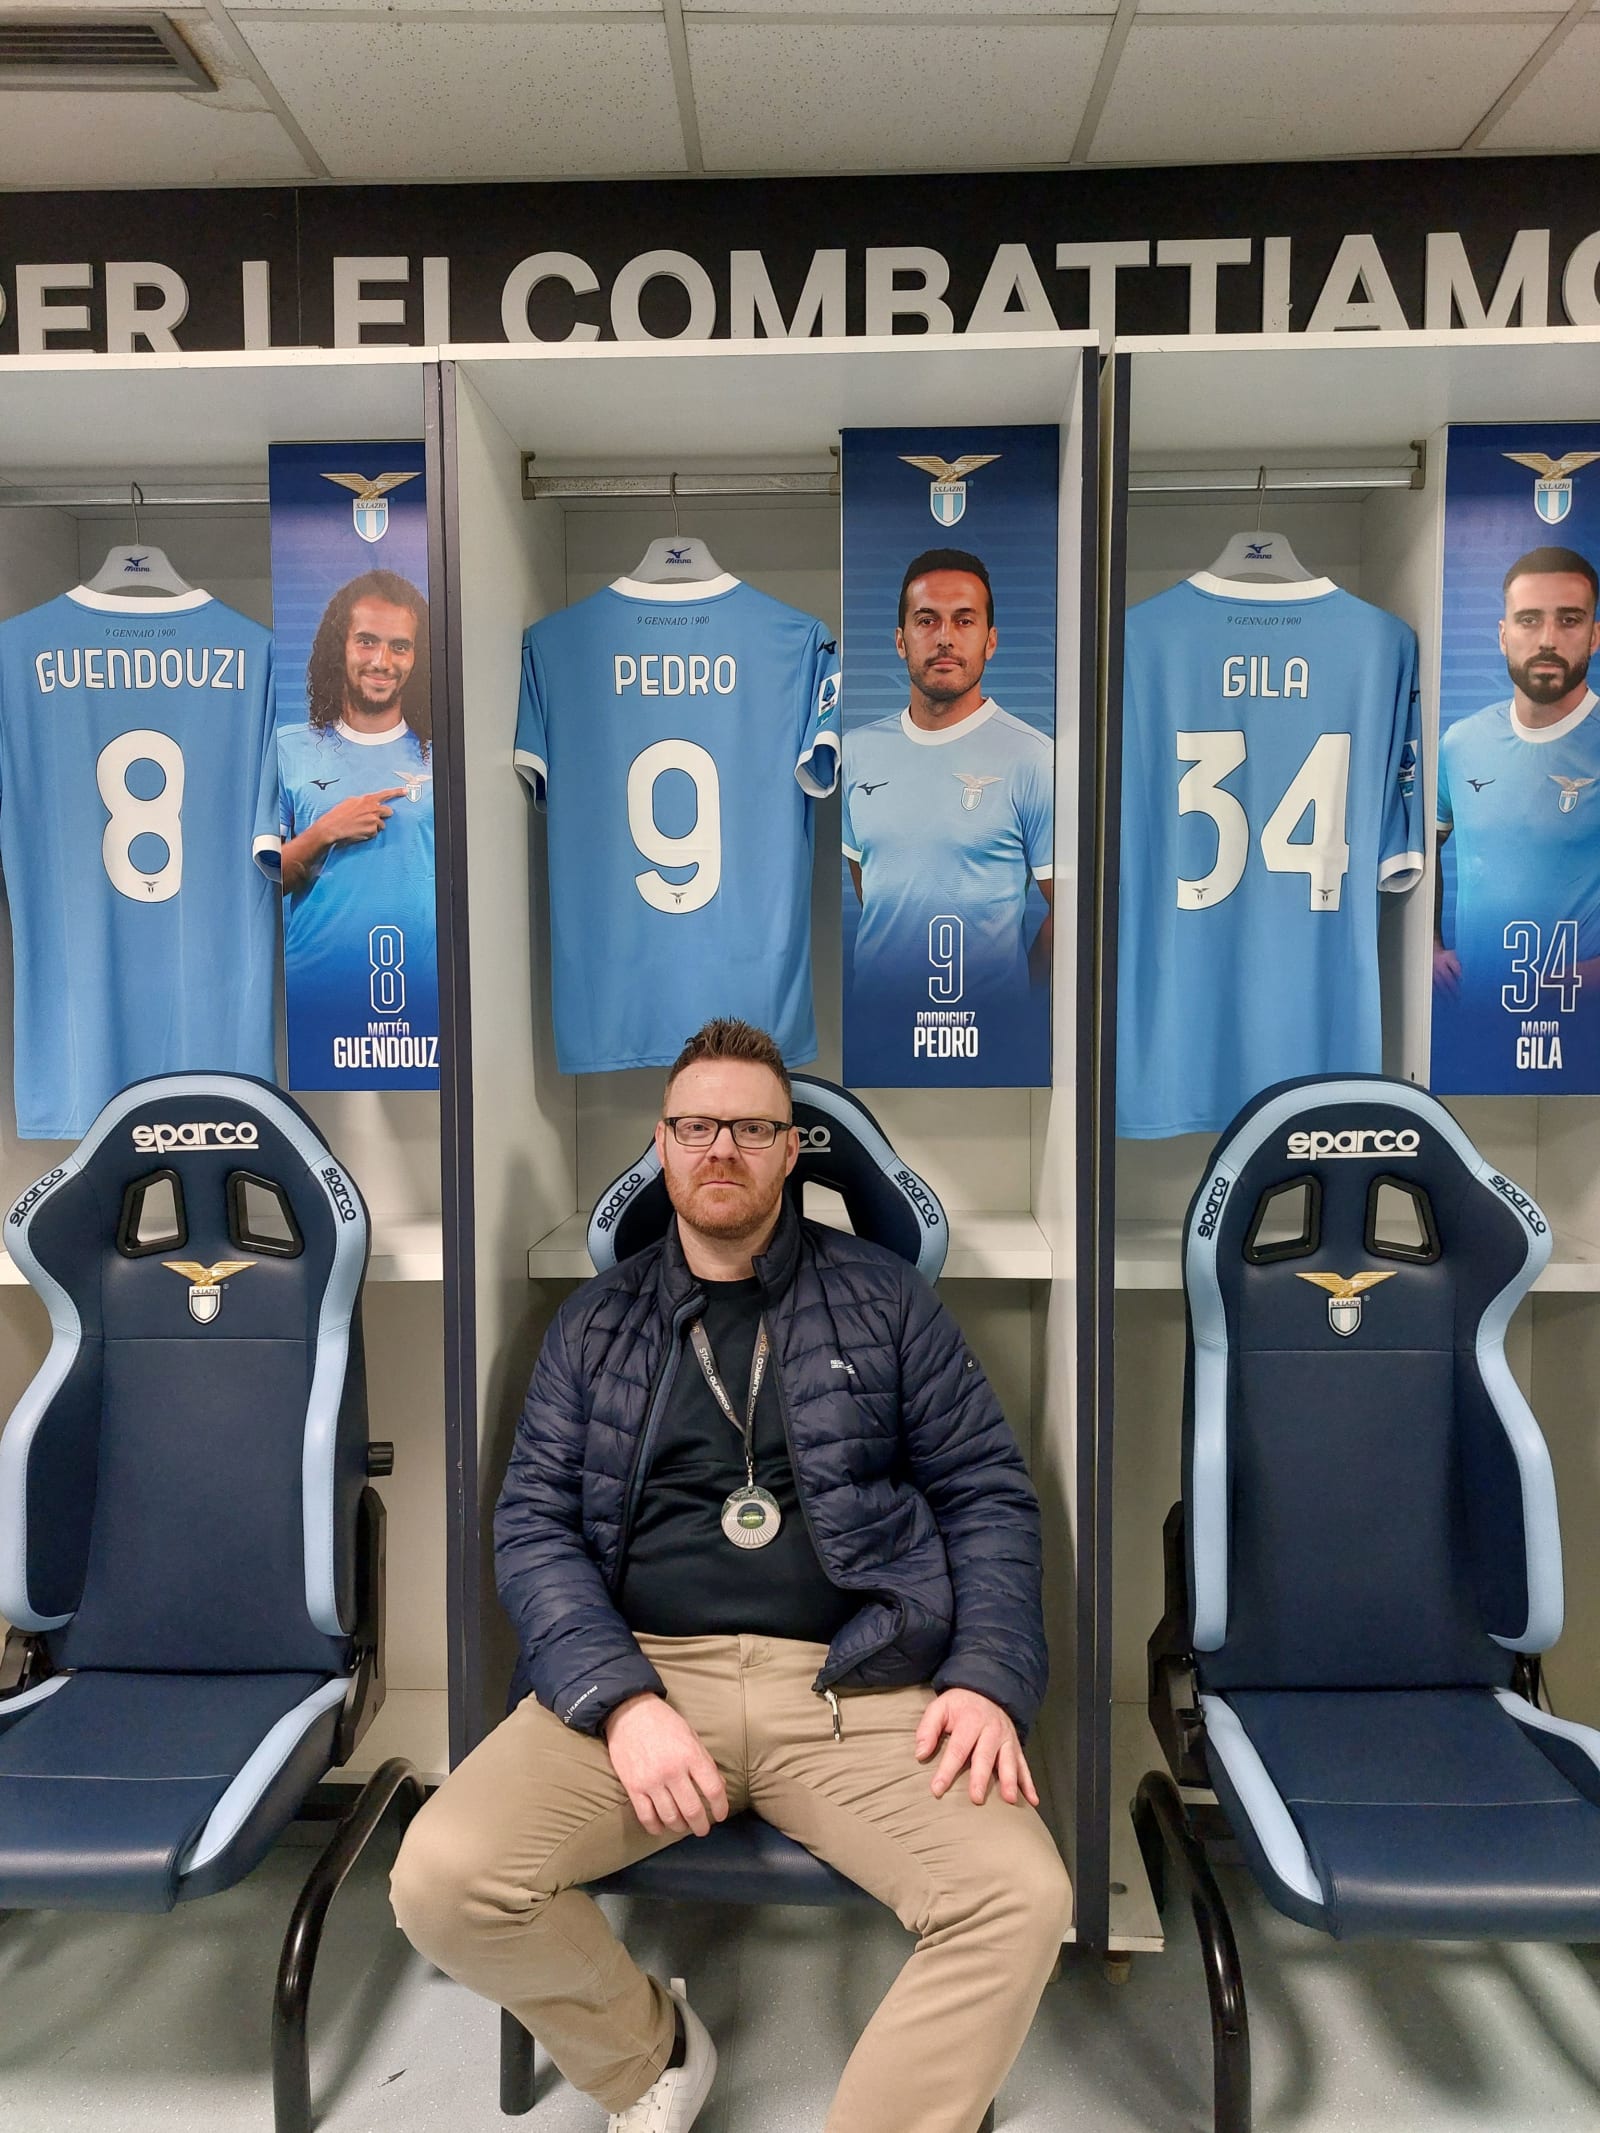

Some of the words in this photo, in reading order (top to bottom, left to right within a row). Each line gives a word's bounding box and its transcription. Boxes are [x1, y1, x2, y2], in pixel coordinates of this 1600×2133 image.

[0, 261, 190, 354] ER
[242, 256, 451, 350] LEI
[104, 628, 111, 637] 9
[112, 628, 155, 639] GENNAIO
[157, 627, 177, 638] 1900
[636, 615, 643, 625] 9
[644, 615, 688, 626] GENNAIO
[690, 615, 710, 625] 1900
[1226, 615, 1233, 625] 9
[1281, 616, 1302, 626] 1900
[35, 648, 246, 694] GUENDOUZI
[613, 653, 737, 697] PEDRO
[1221, 655, 1309, 699] GILA
[96, 729, 185, 902] 8
[627, 738, 721, 914] 9
[1176, 730, 1351, 912] 34
[368, 925, 405, 1014] 8
[928, 915, 964, 1004] 9
[1501, 920, 1582, 1013] 34
[333, 1036, 440, 1068] GUENDOUZ
[914, 1026, 979, 1058] PEDRO
[1516, 1036, 1563, 1069] GILA
[1521, 1021, 1559, 1036] MARIO
[131, 1121, 259, 1153] sparco
[1287, 1129, 1420, 1160] sparco
[8, 1168, 67, 1228] sparco
[322, 1166, 357, 1224] sparco
[597, 1173, 645, 1232] sparco
[893, 1170, 940, 1228] sparco
[1197, 1176, 1230, 1240] sparco
[1488, 1174, 1547, 1237] sparco
[699, 1347, 714, 1375] STADIO
[709, 1375, 730, 1410] OLIMPICO
[752, 1357, 764, 1396] OLIMPICO
[758, 1334, 768, 1356] TOUR
